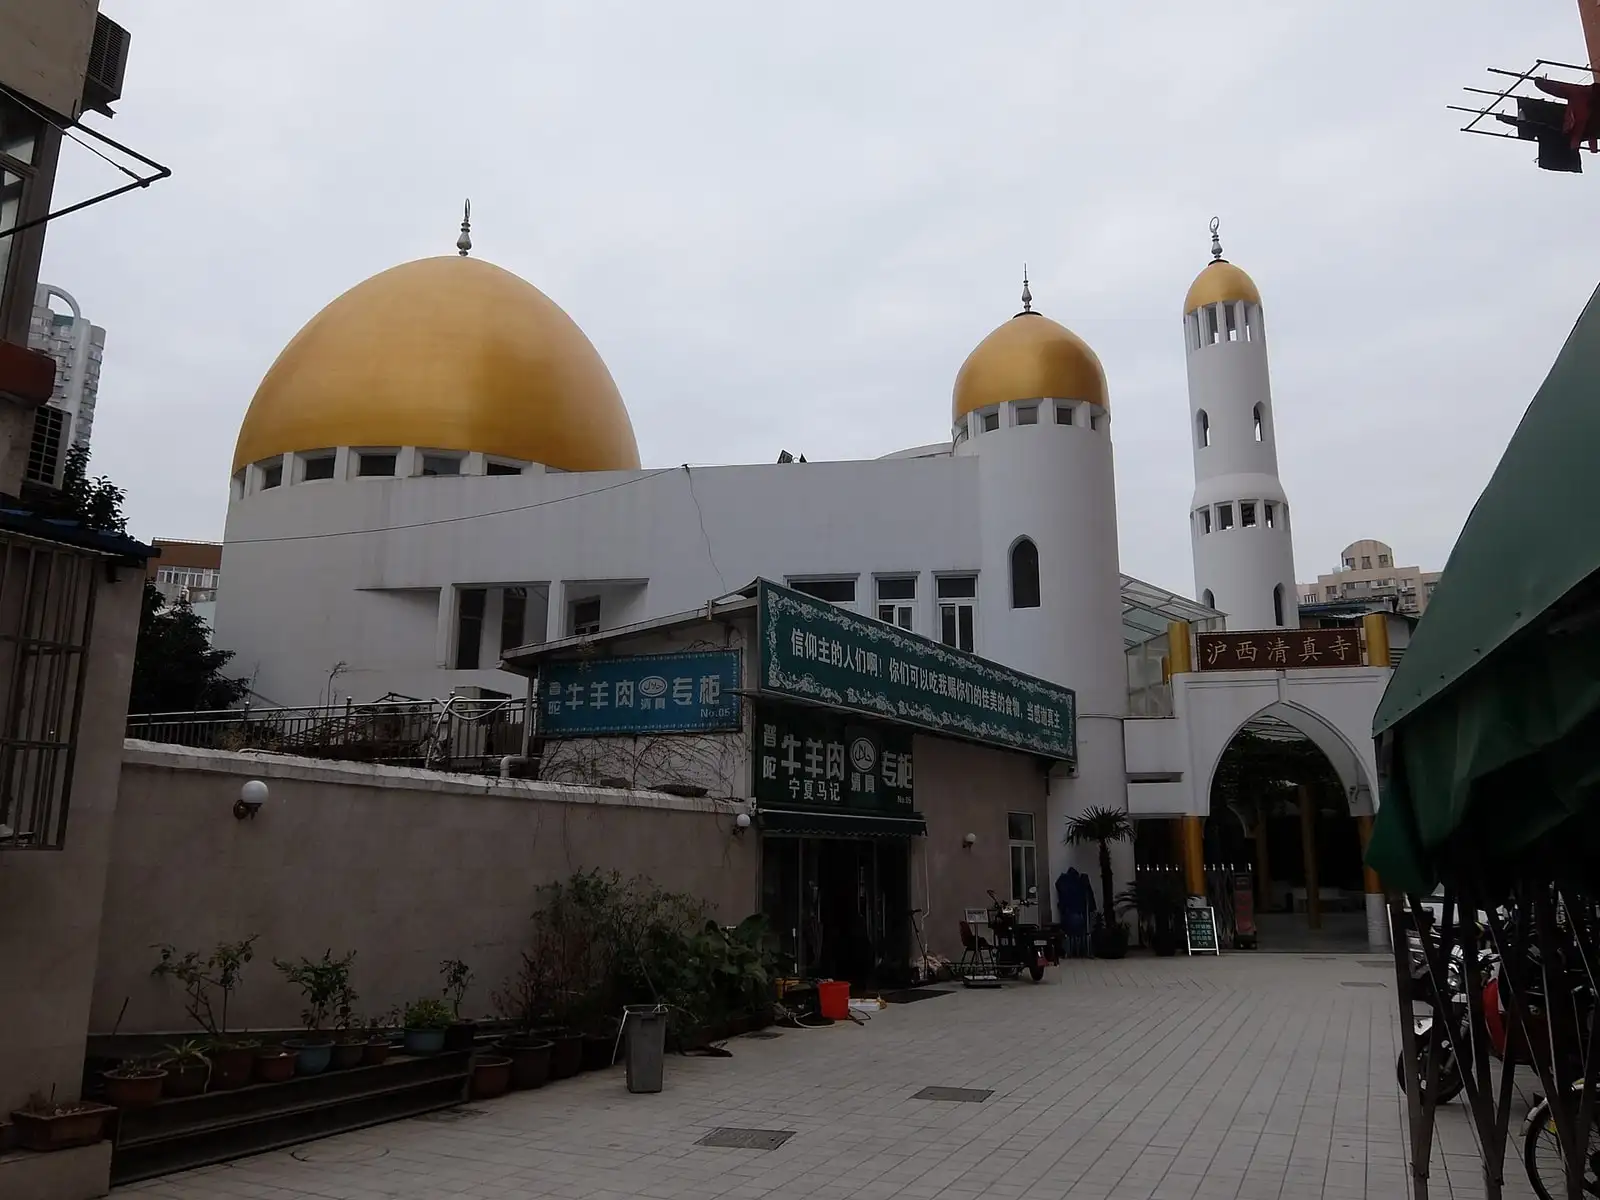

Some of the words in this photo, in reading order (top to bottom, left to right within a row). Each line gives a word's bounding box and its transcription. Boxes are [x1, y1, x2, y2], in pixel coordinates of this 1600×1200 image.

[1206, 635, 1352, 665] 沪西清真寺
[565, 679, 635, 710] 牛羊肉
[672, 674, 720, 706] 专柜
[640, 697, 666, 710] 清真
[763, 723, 777, 780] 普陀
[780, 733, 845, 781] 牛羊肉
[880, 750, 913, 789] 专柜
[788, 776, 841, 801] 宁夏马记
[850, 771, 876, 793] 清真
